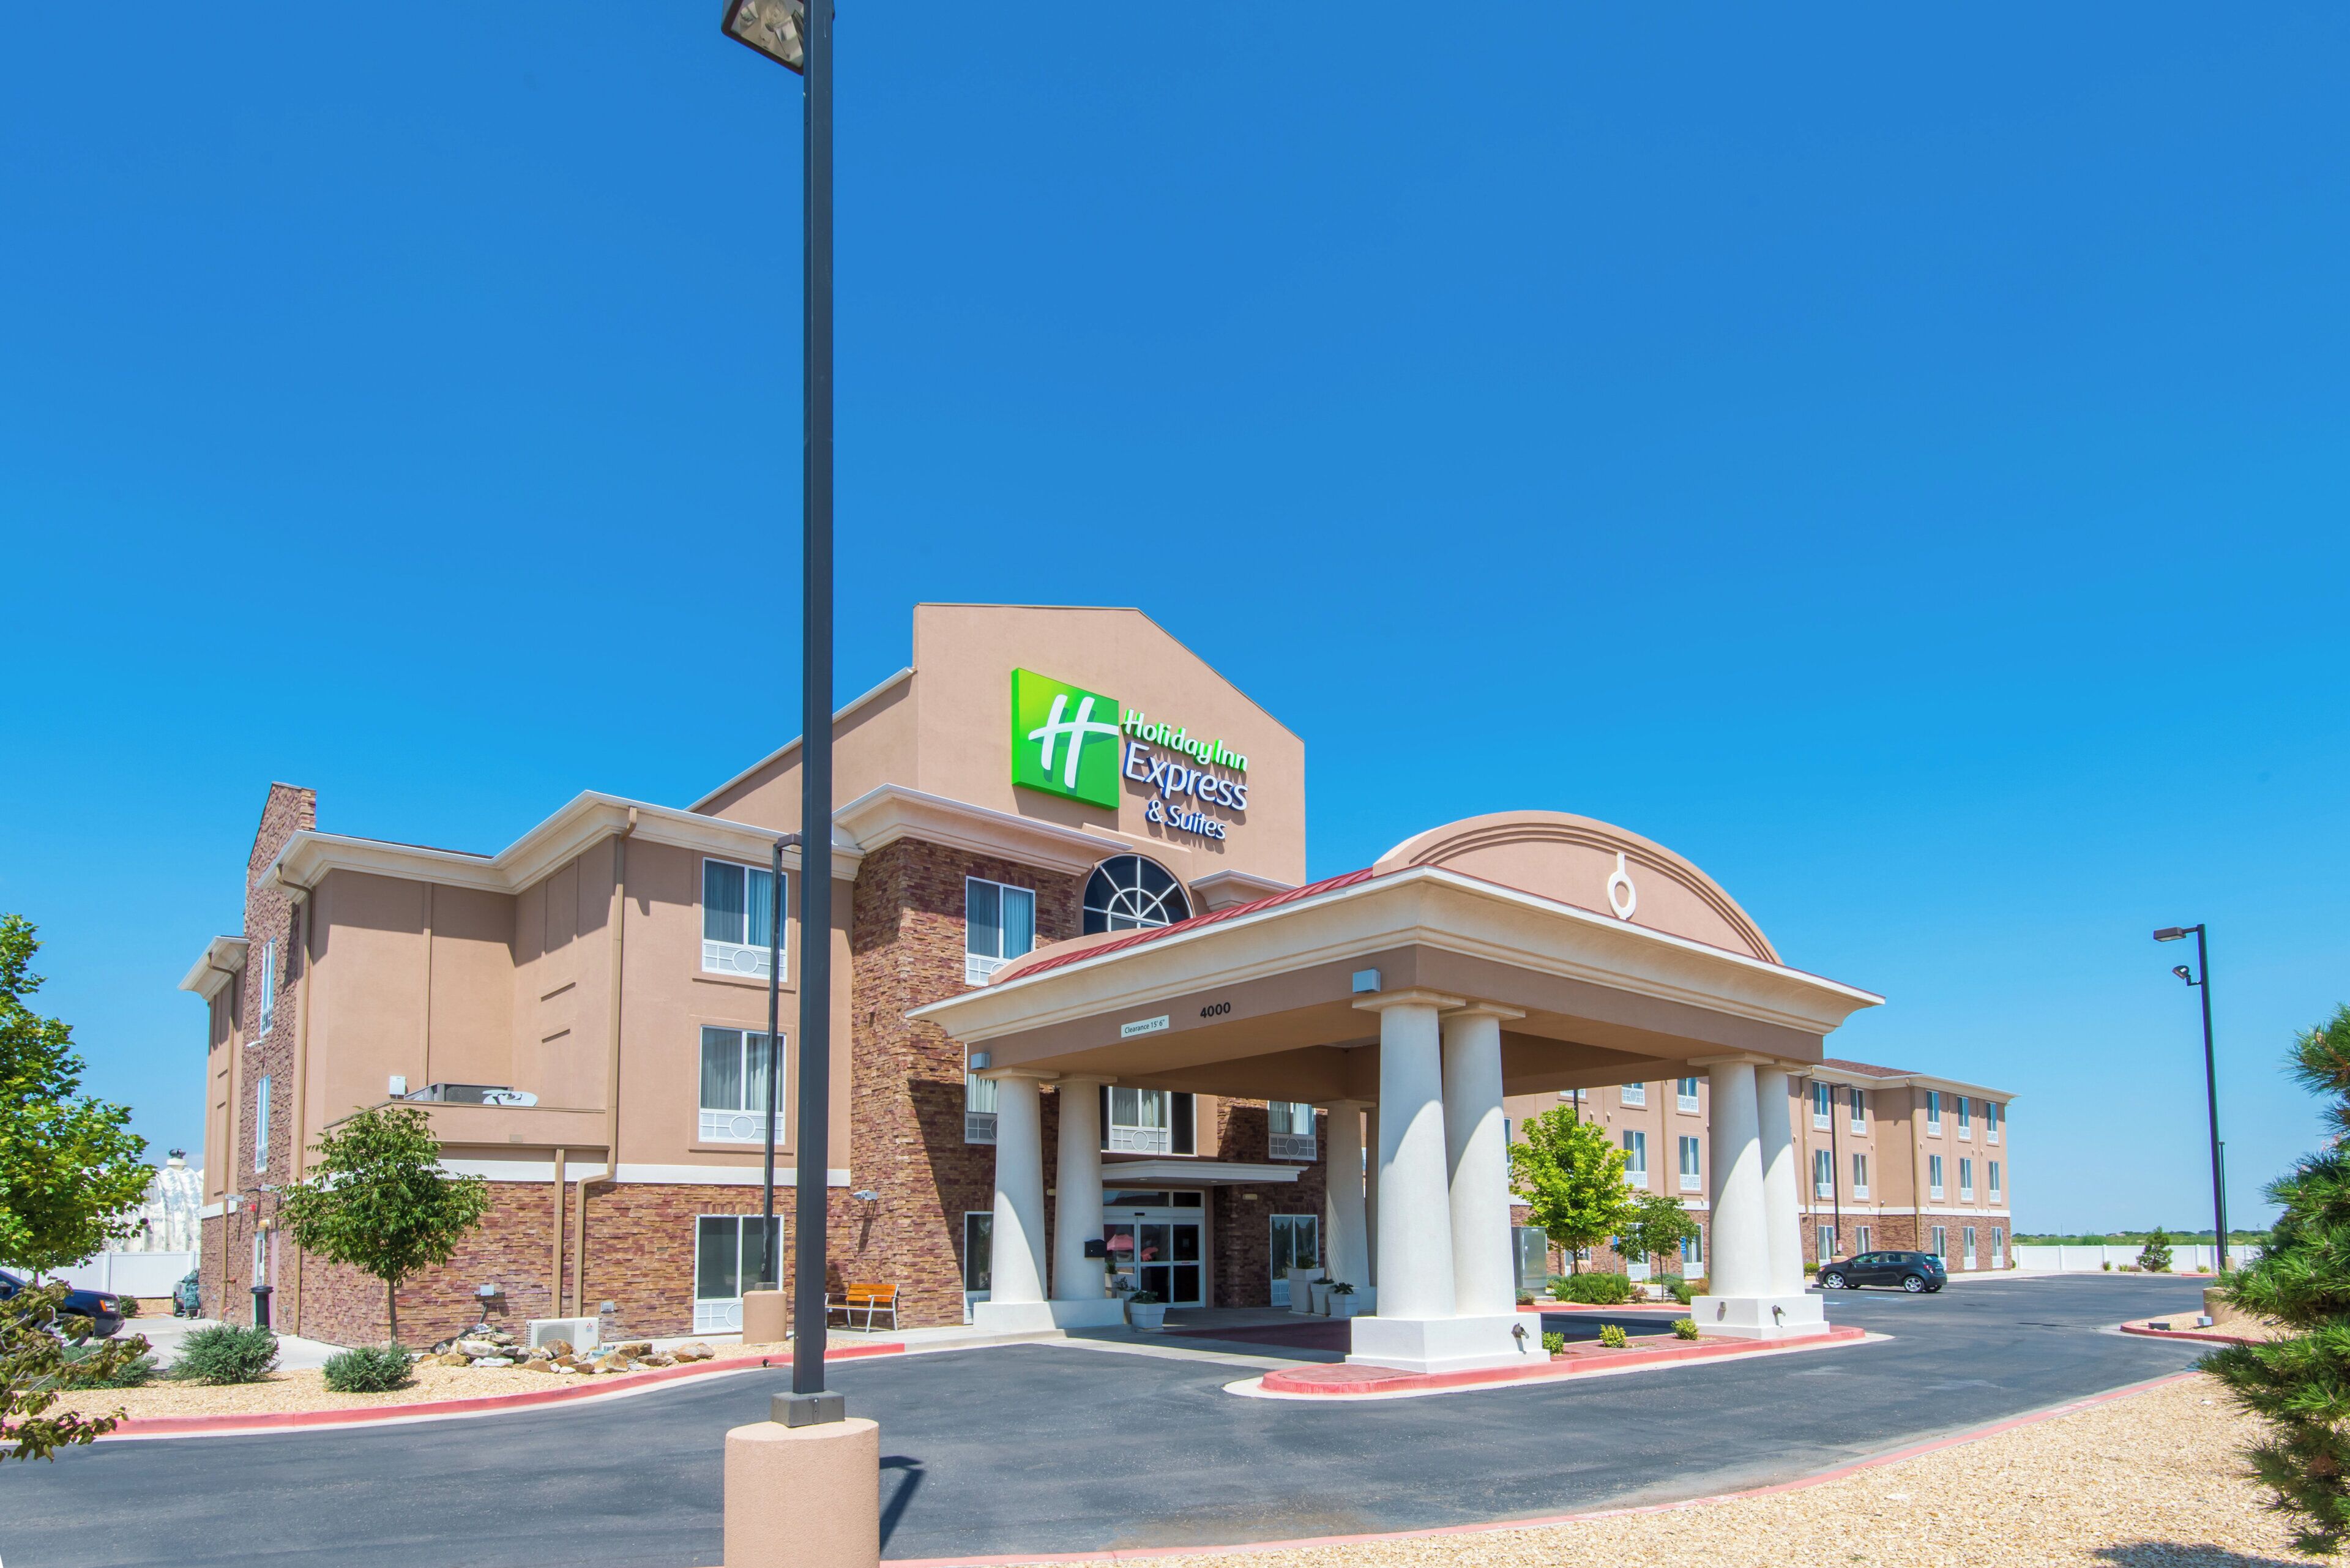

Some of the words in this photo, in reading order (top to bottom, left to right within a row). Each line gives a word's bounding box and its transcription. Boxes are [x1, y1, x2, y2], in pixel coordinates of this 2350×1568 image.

[1121, 708, 1212, 765] Holiday
[1212, 739, 1248, 772] Inn
[1123, 741, 1248, 811] Express
[1146, 799, 1163, 823] &
[1165, 805, 1226, 840] Suites
[1124, 1024, 1150, 1034] Clearance
[1200, 1002, 1231, 1018] 4000
